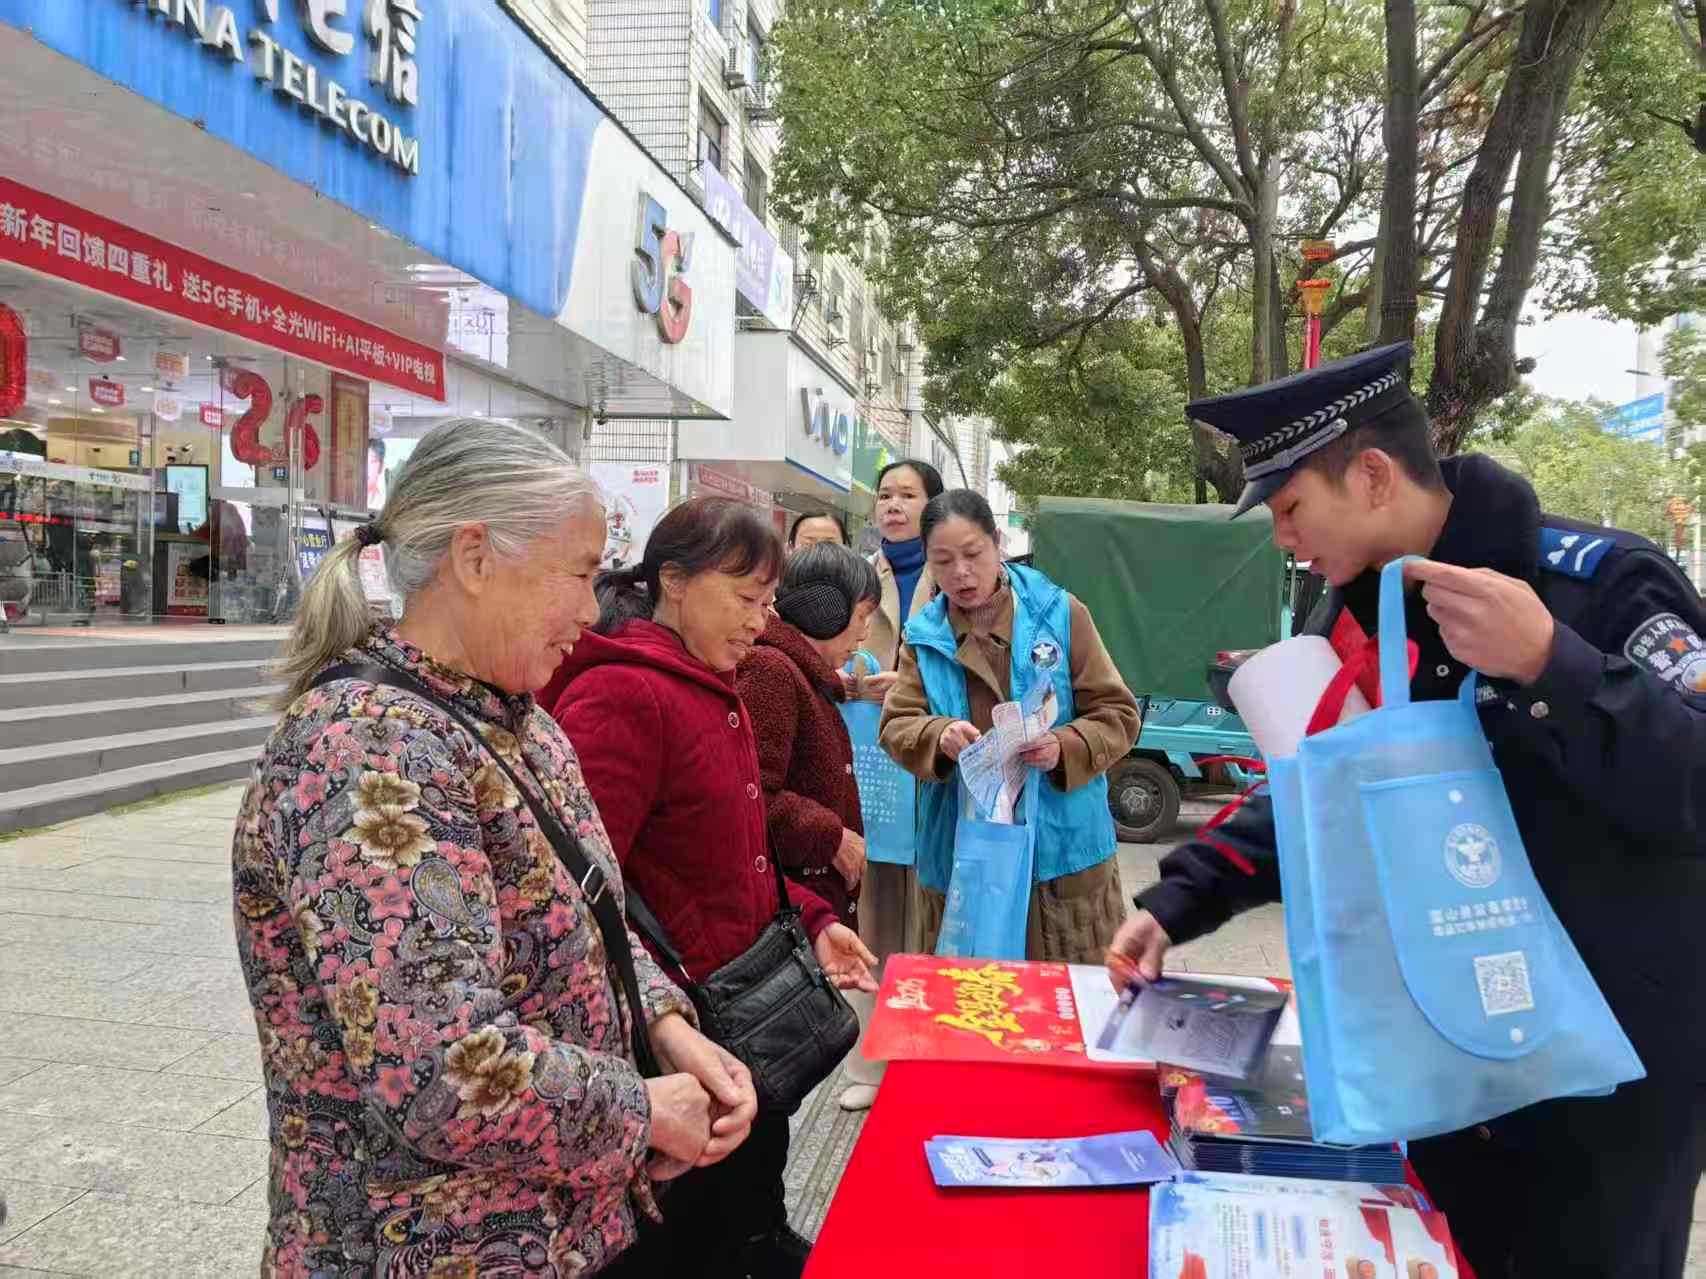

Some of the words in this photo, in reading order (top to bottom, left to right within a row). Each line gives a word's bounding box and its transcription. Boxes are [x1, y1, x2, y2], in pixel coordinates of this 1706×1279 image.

[250, 28, 419, 176] TELECOM
[0, 202, 174, 293] 新年回馈四重礼
[631, 191, 695, 345] 5G
